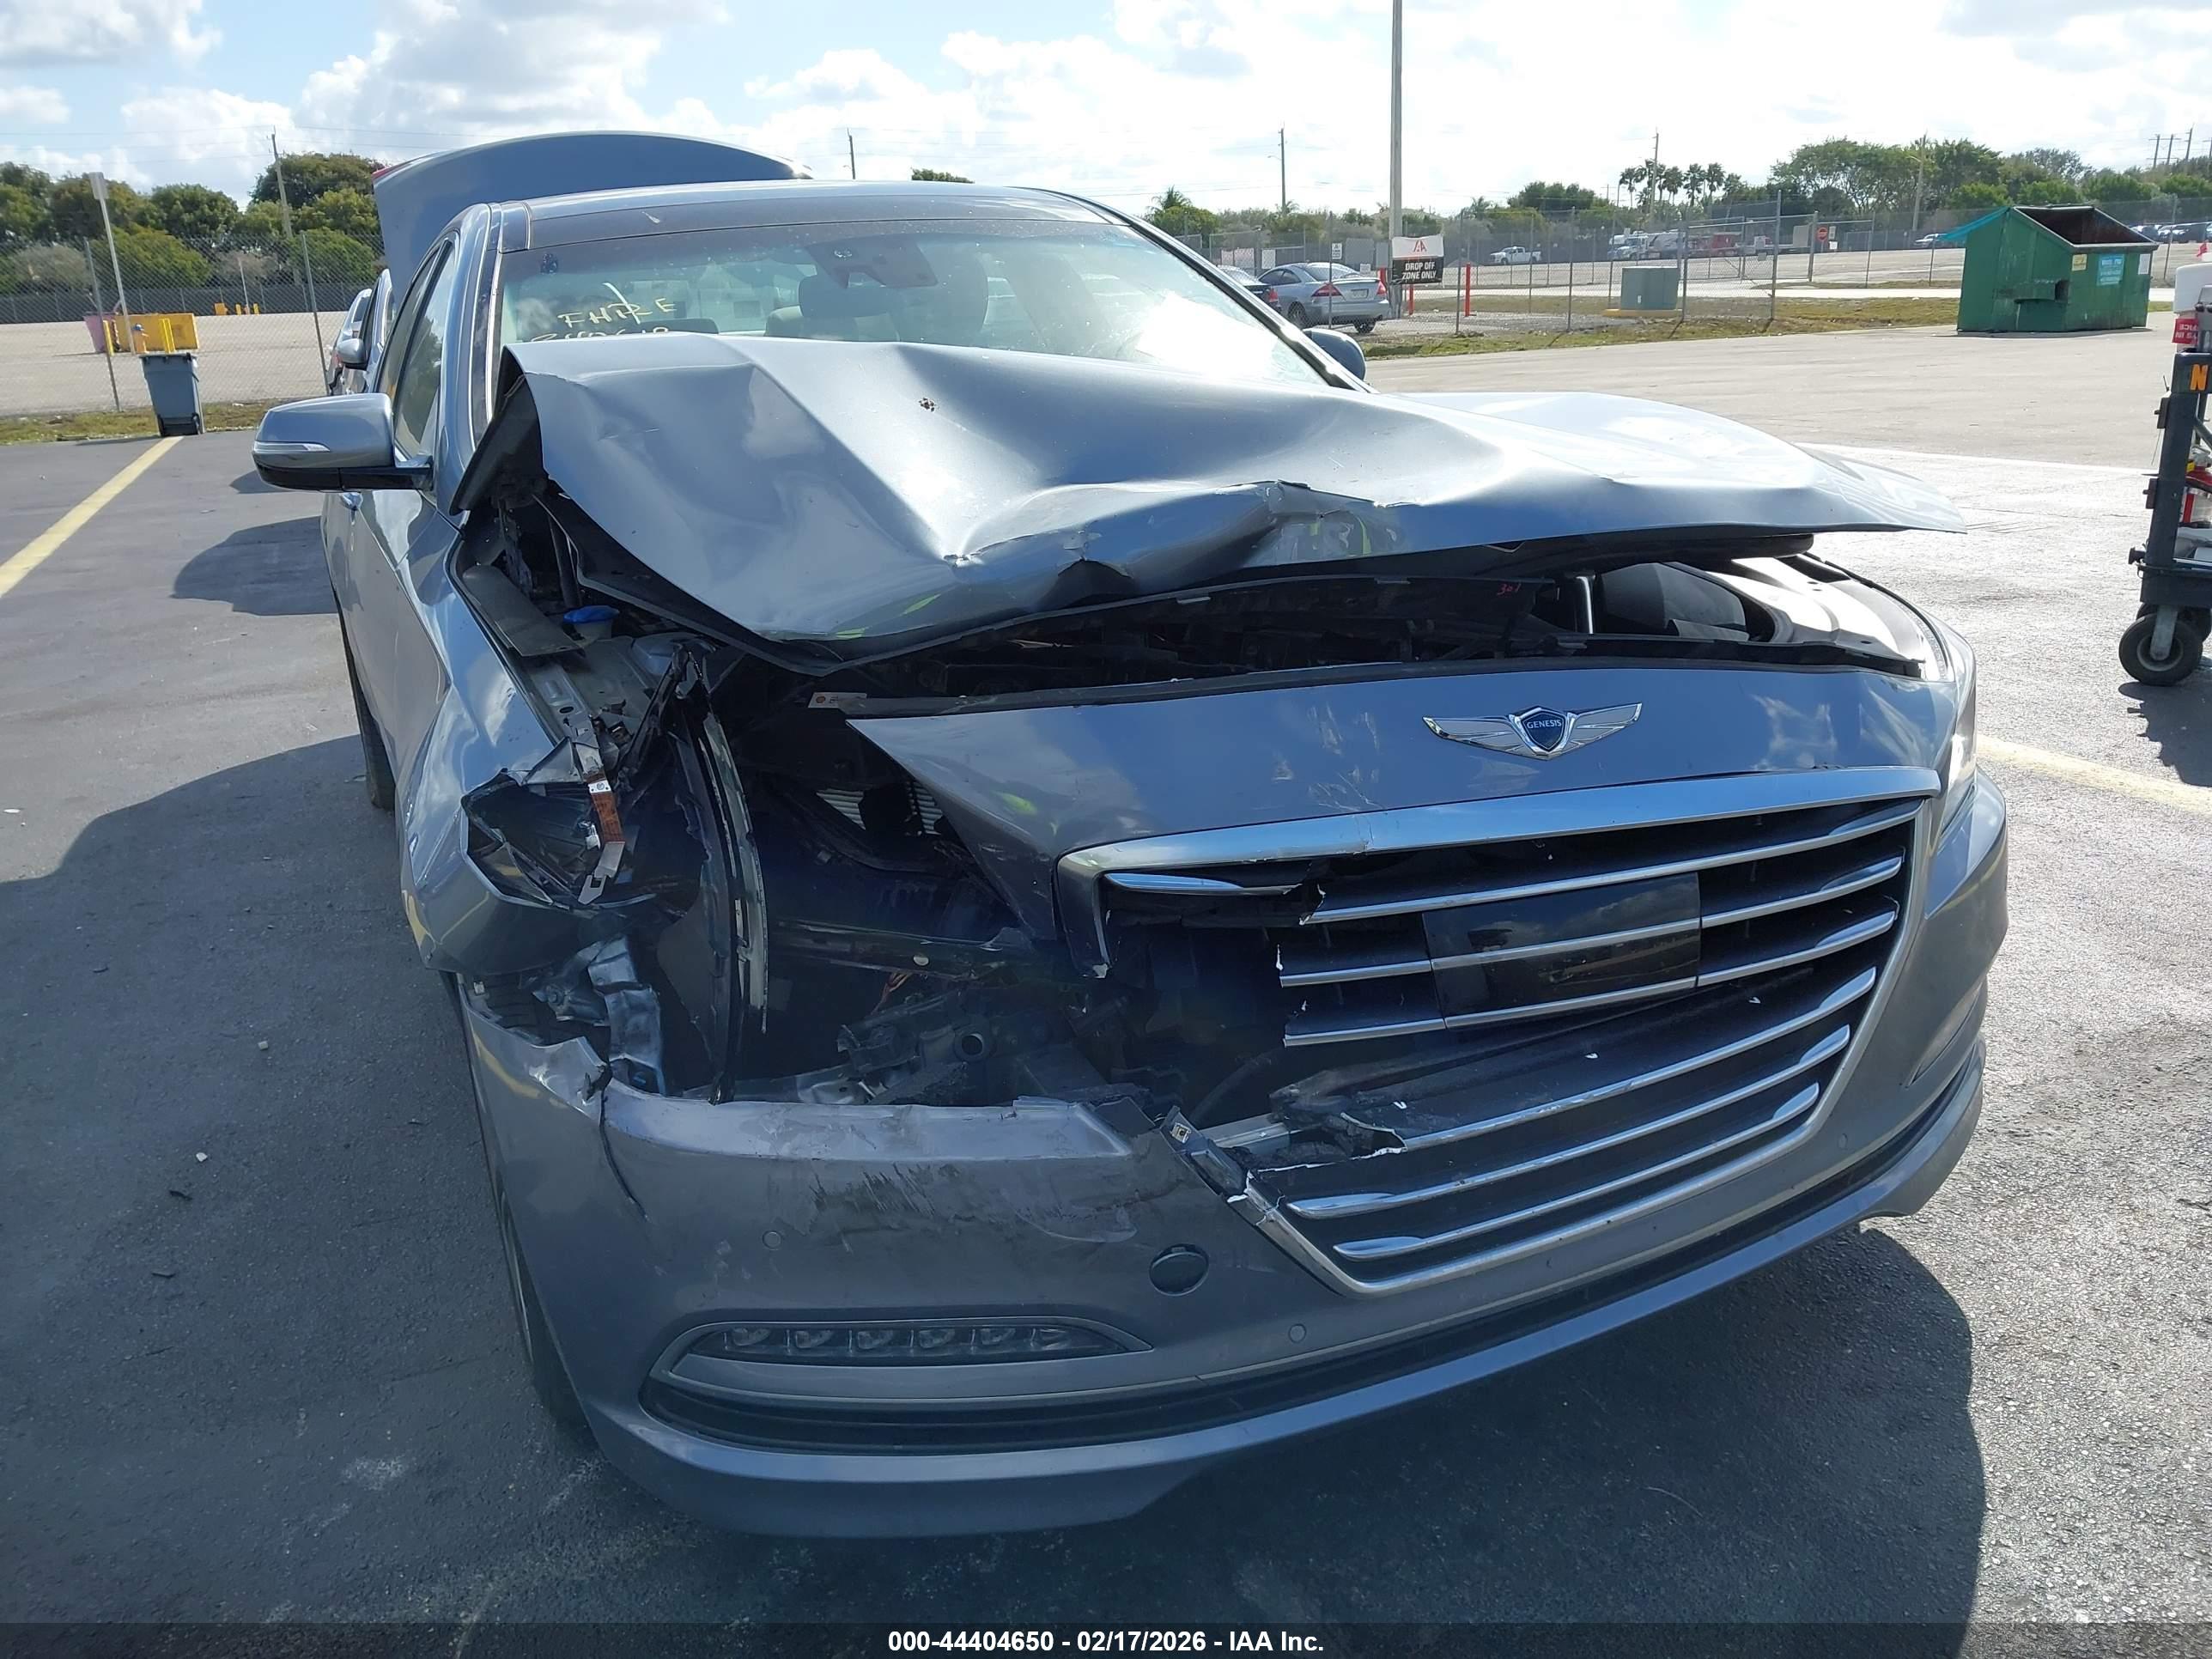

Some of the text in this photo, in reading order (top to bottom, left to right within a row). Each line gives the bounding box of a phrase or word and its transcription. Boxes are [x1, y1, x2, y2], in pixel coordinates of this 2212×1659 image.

[1405, 261, 1435, 270] DROP OFF
[1401, 270, 1436, 280] ZONE ONLY
[1527, 720, 1562, 729] GENESIS
